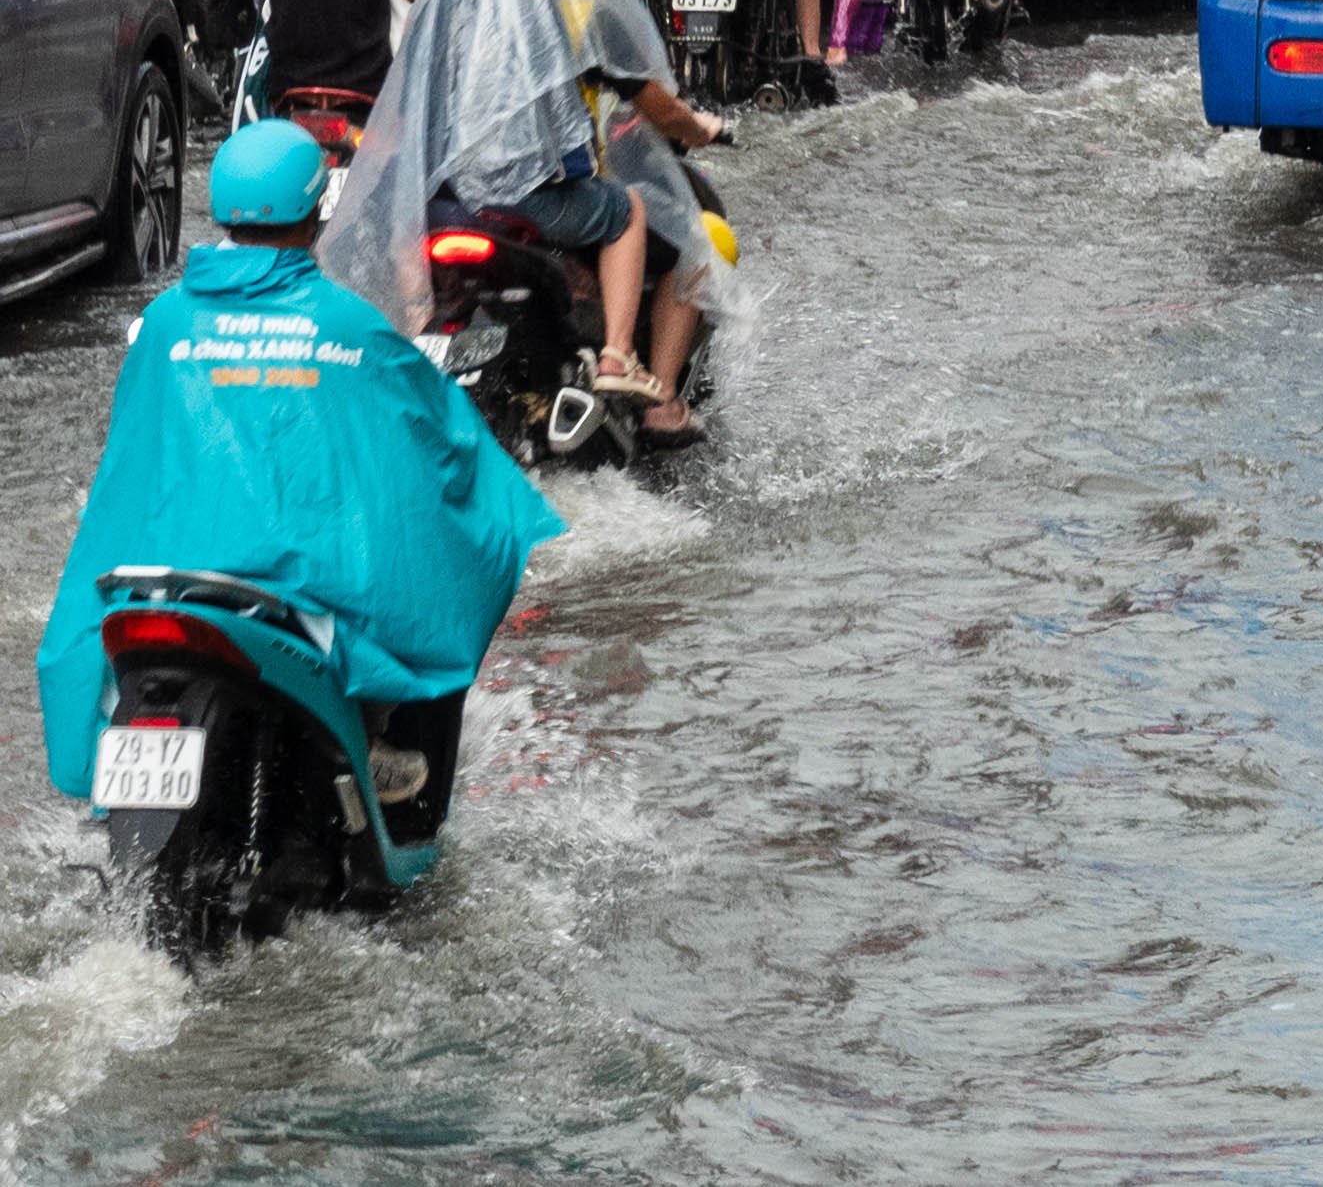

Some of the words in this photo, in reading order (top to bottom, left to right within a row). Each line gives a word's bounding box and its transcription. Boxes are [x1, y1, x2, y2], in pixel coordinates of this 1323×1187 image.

[246, 339, 314, 361] XANH
[113, 731, 189, 765] 29-Y7
[102, 769, 192, 801] 703.80
